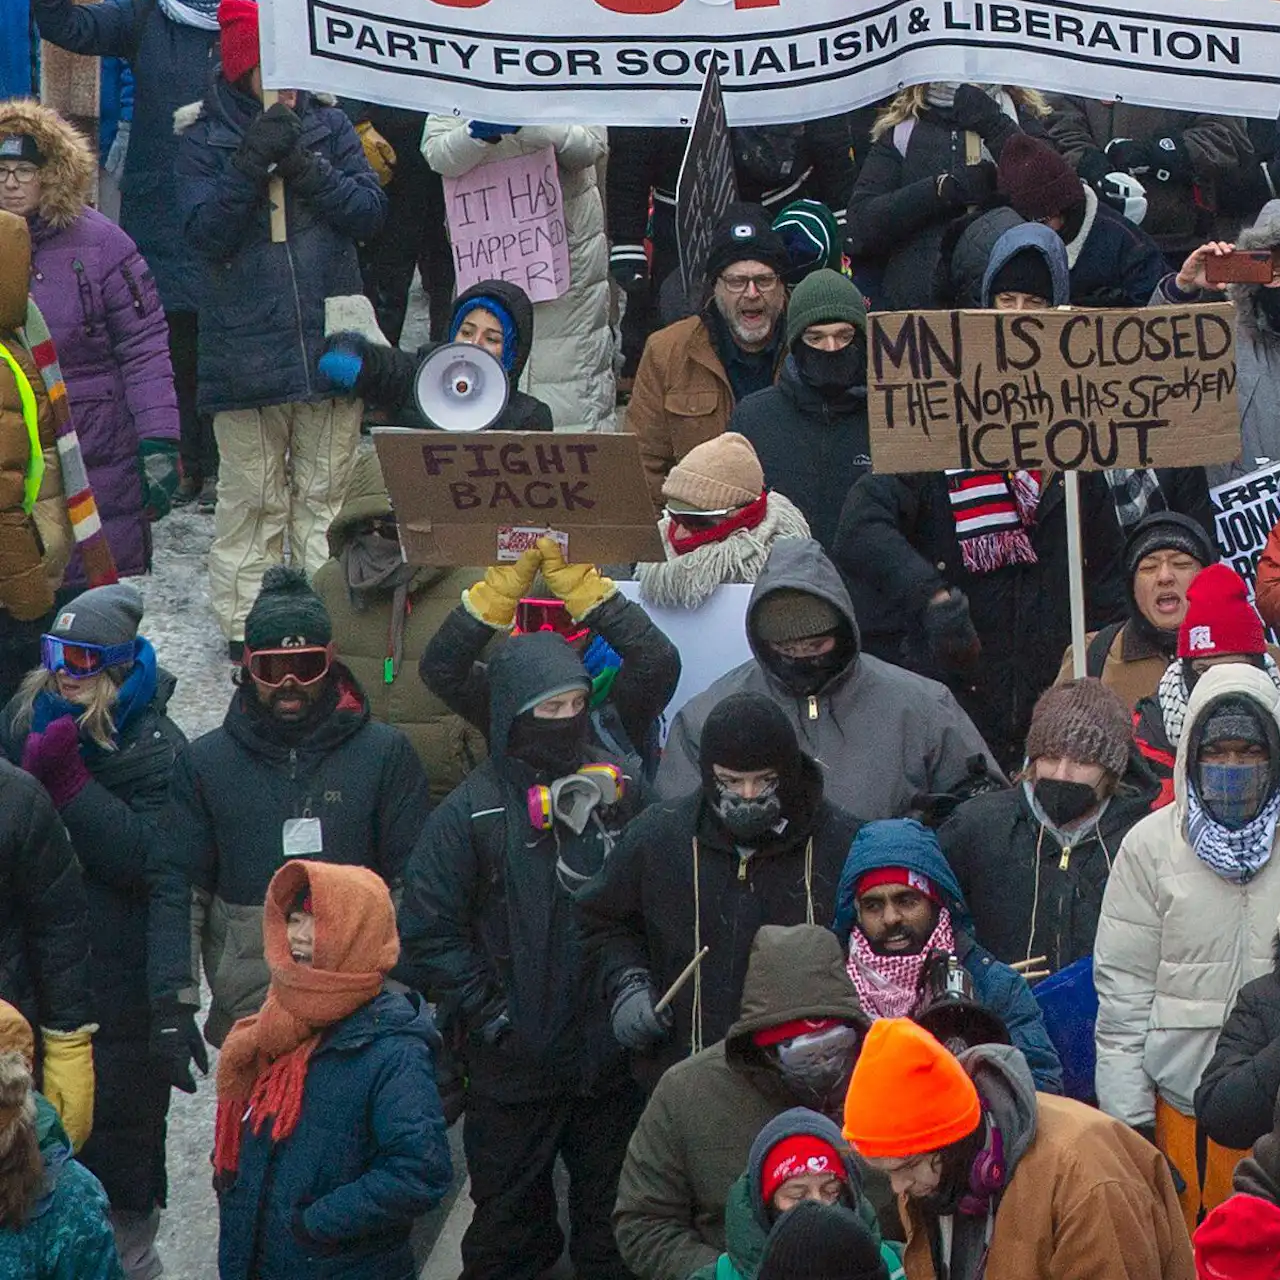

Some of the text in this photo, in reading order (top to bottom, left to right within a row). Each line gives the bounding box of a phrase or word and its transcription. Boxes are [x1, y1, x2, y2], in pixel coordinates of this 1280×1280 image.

[326, 1, 1242, 77] PARTY FOR SOCIALISM & LIBERATION
[455, 164, 559, 228] IT HAS
[867, 311, 1235, 382] MN IS CLOSED
[873, 372, 1121, 438] THE HAS
[421, 443, 600, 480] FIGHT
[449, 481, 598, 514] BACK
